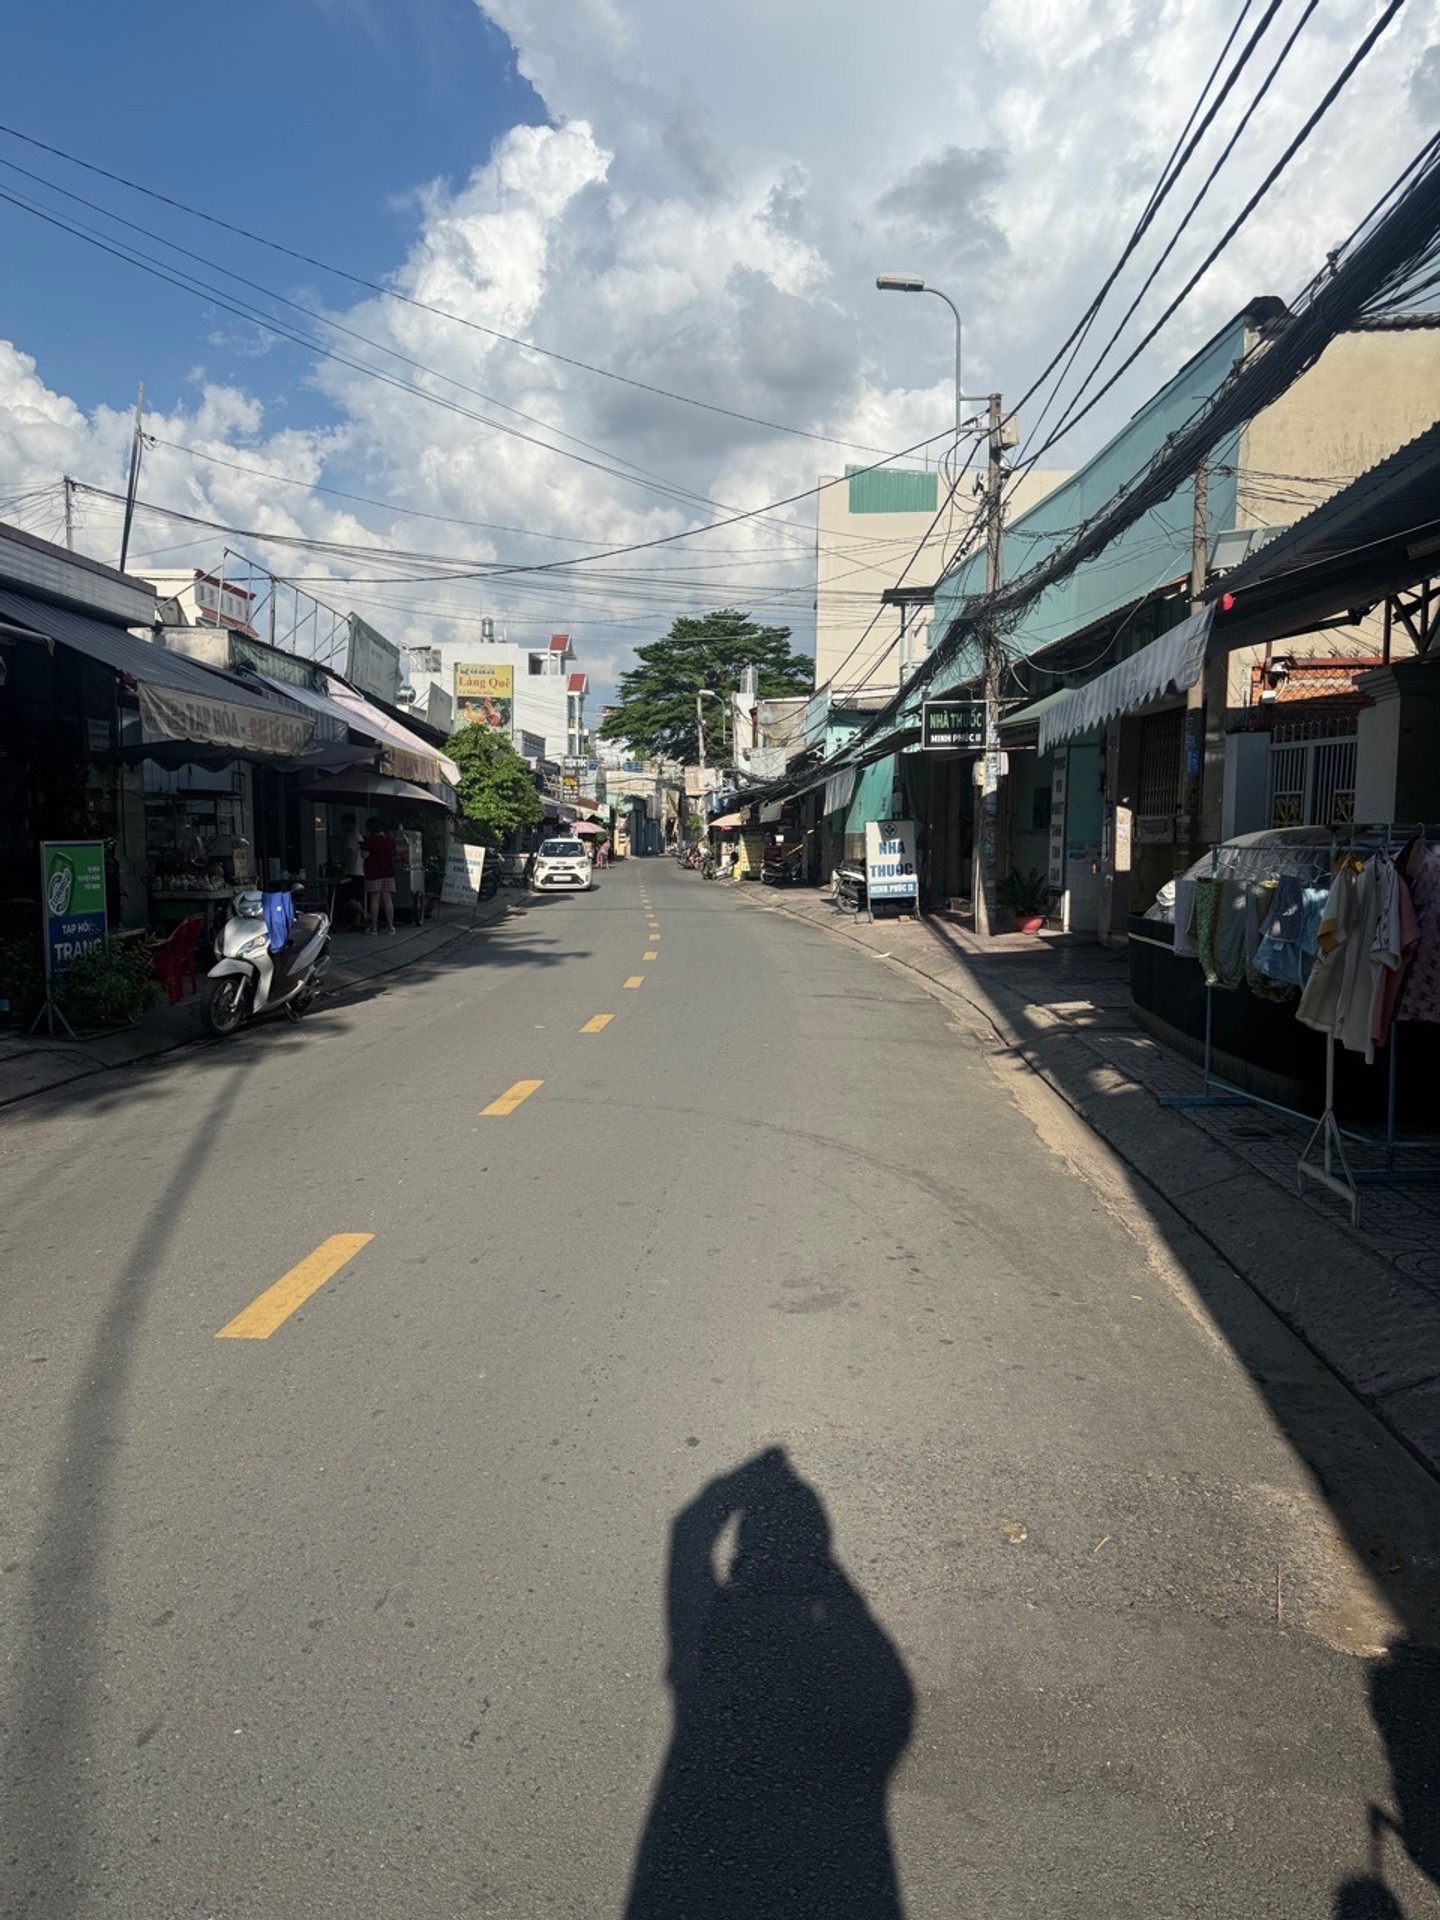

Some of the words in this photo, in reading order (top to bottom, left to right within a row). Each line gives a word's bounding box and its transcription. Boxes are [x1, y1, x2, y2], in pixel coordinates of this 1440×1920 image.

[458, 676, 487, 689] Làng
[489, 677, 512, 690] Quê
[929, 709, 950, 729] NHÀ
[950, 707, 982, 729] THUỐC
[930, 733, 951, 743] MINH
[953, 732, 974, 743] PHÚC
[61, 924, 76, 936] TẠP
